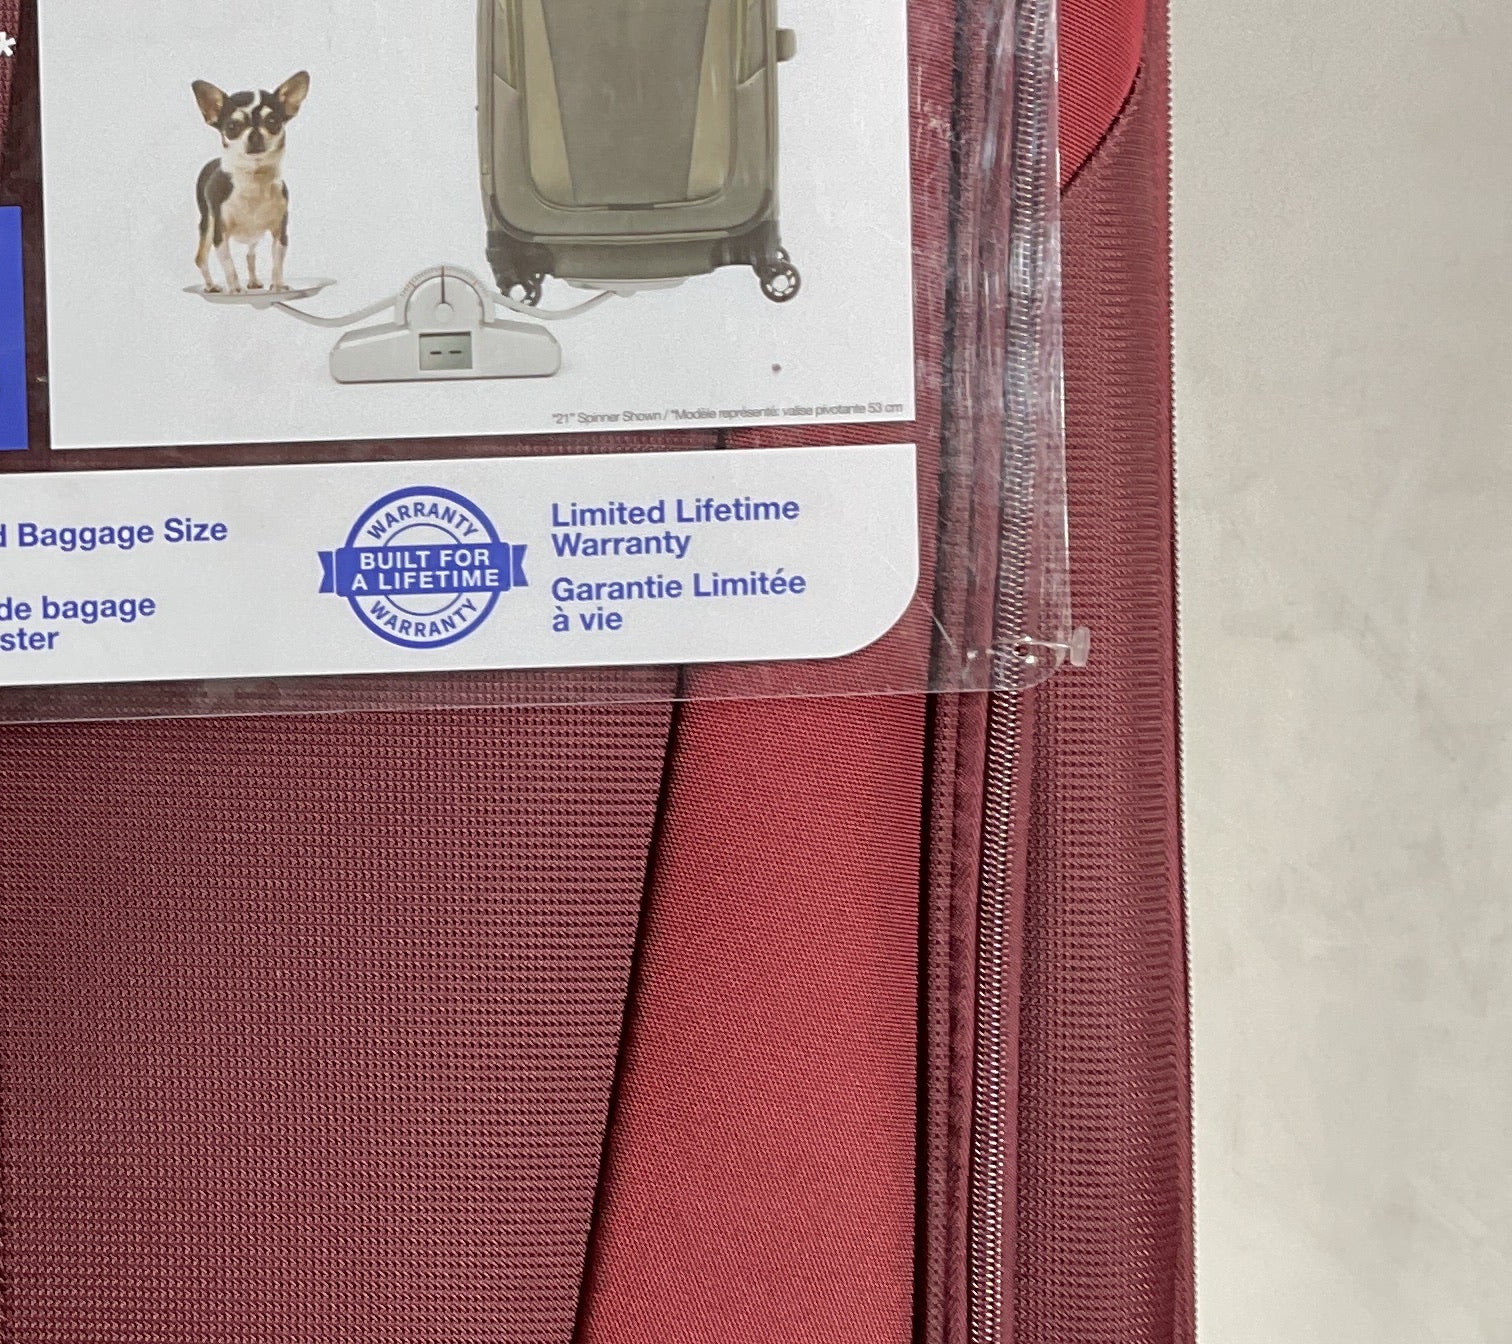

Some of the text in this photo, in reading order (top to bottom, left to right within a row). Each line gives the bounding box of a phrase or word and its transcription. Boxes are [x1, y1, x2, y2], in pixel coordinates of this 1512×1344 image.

[577, 412, 620, 424] Spinner
[623, 411, 661, 422] Shown
[815, 404, 866, 417] pivotante
[867, 403, 882, 413] 53
[885, 404, 904, 413] cm
[366, 500, 480, 542] WARRANTY
[551, 496, 801, 528] Limited Lifetime
[18, 519, 155, 552] Baggage
[164, 517, 229, 542] Size
[551, 531, 693, 559] Warranty
[360, 548, 491, 572] BUILT FOR
[351, 568, 500, 592] A LIFETIME
[551, 568, 807, 603] Garantie Limitée
[41, 594, 157, 624] bagage
[369, 598, 479, 638] WARRANTY
[552, 606, 624, 632] à vie
